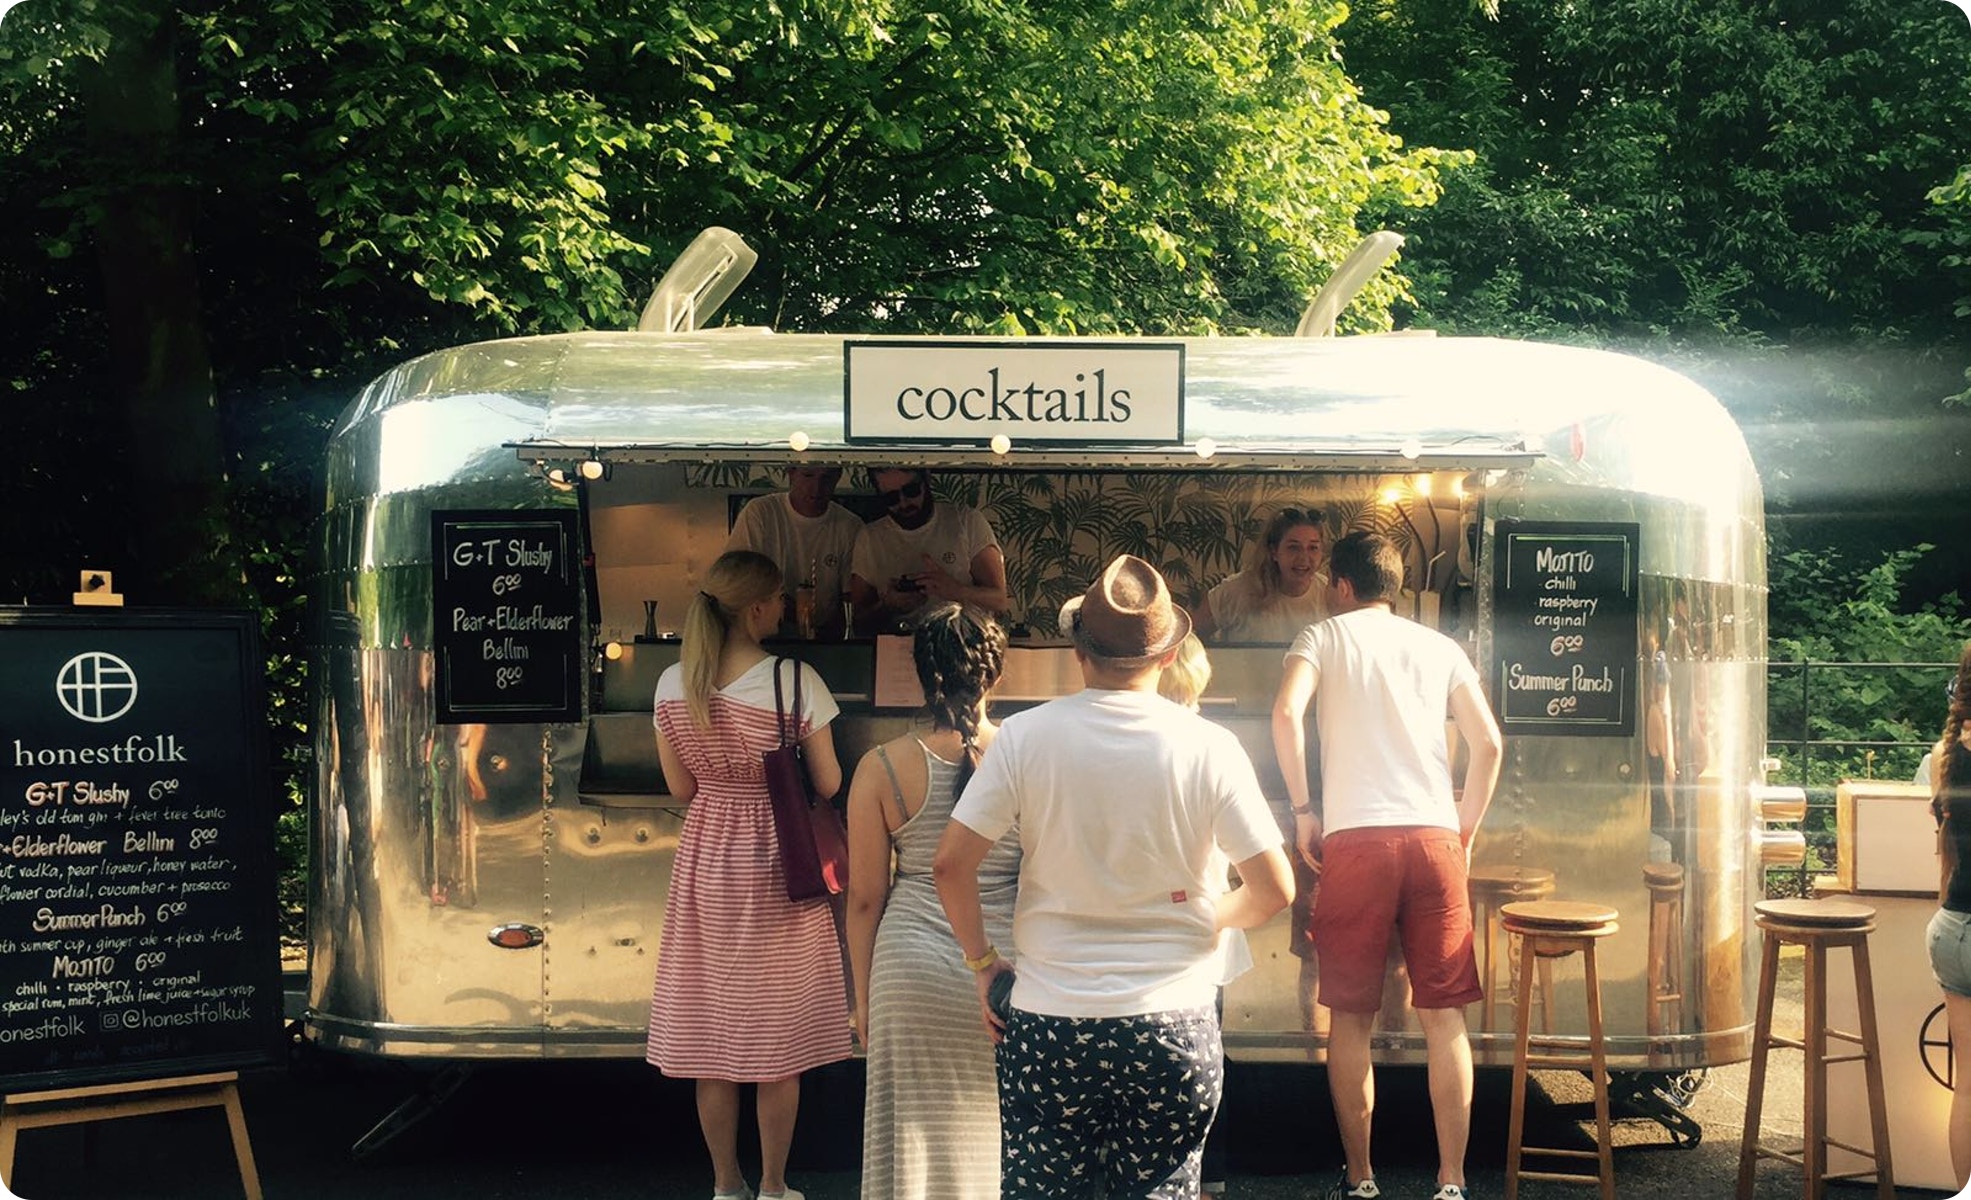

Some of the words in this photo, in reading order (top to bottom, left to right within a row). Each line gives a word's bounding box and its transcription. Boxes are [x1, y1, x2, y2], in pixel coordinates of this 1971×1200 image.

[896, 367, 1132, 423] cocktails
[452, 539, 501, 566] G+T
[505, 539, 553, 574] Slushy
[1544, 575, 1577, 590] chilli
[1539, 594, 1598, 617] raspberry
[1534, 612, 1587, 632] original
[483, 637, 529, 660] Bellini
[1508, 663, 1570, 691] Summer
[1572, 664, 1613, 692] Punch
[13, 734, 188, 767] honestfolk
[73, 781, 130, 809] Slushy
[36, 809, 57, 825] old
[59, 808, 83, 823] tom
[83, 811, 108, 829] gin
[128, 805, 157, 824] fever
[163, 806, 188, 820] tree
[192, 804, 227, 819] tonic
[123, 831, 175, 853] Bellini
[67, 865, 98, 884] pear
[152, 856, 187, 877] honey
[180, 881, 231, 900] prosecco
[20, 940, 62, 952] summer
[93, 936, 137, 954] ginger
[139, 929, 158, 946] ale
[175, 927, 205, 948] fresh
[210, 926, 244, 942] fruit
[15, 981, 48, 996] chilli
[68, 977, 130, 999] raspberry
[152, 969, 200, 990] original
[2, 997, 39, 1018] special
[103, 990, 134, 1006] fresh
[137, 988, 162, 1003] lime
[0, 1015, 86, 1043] onestfolk
[122, 1000, 252, 1029] @honestfolkuk
